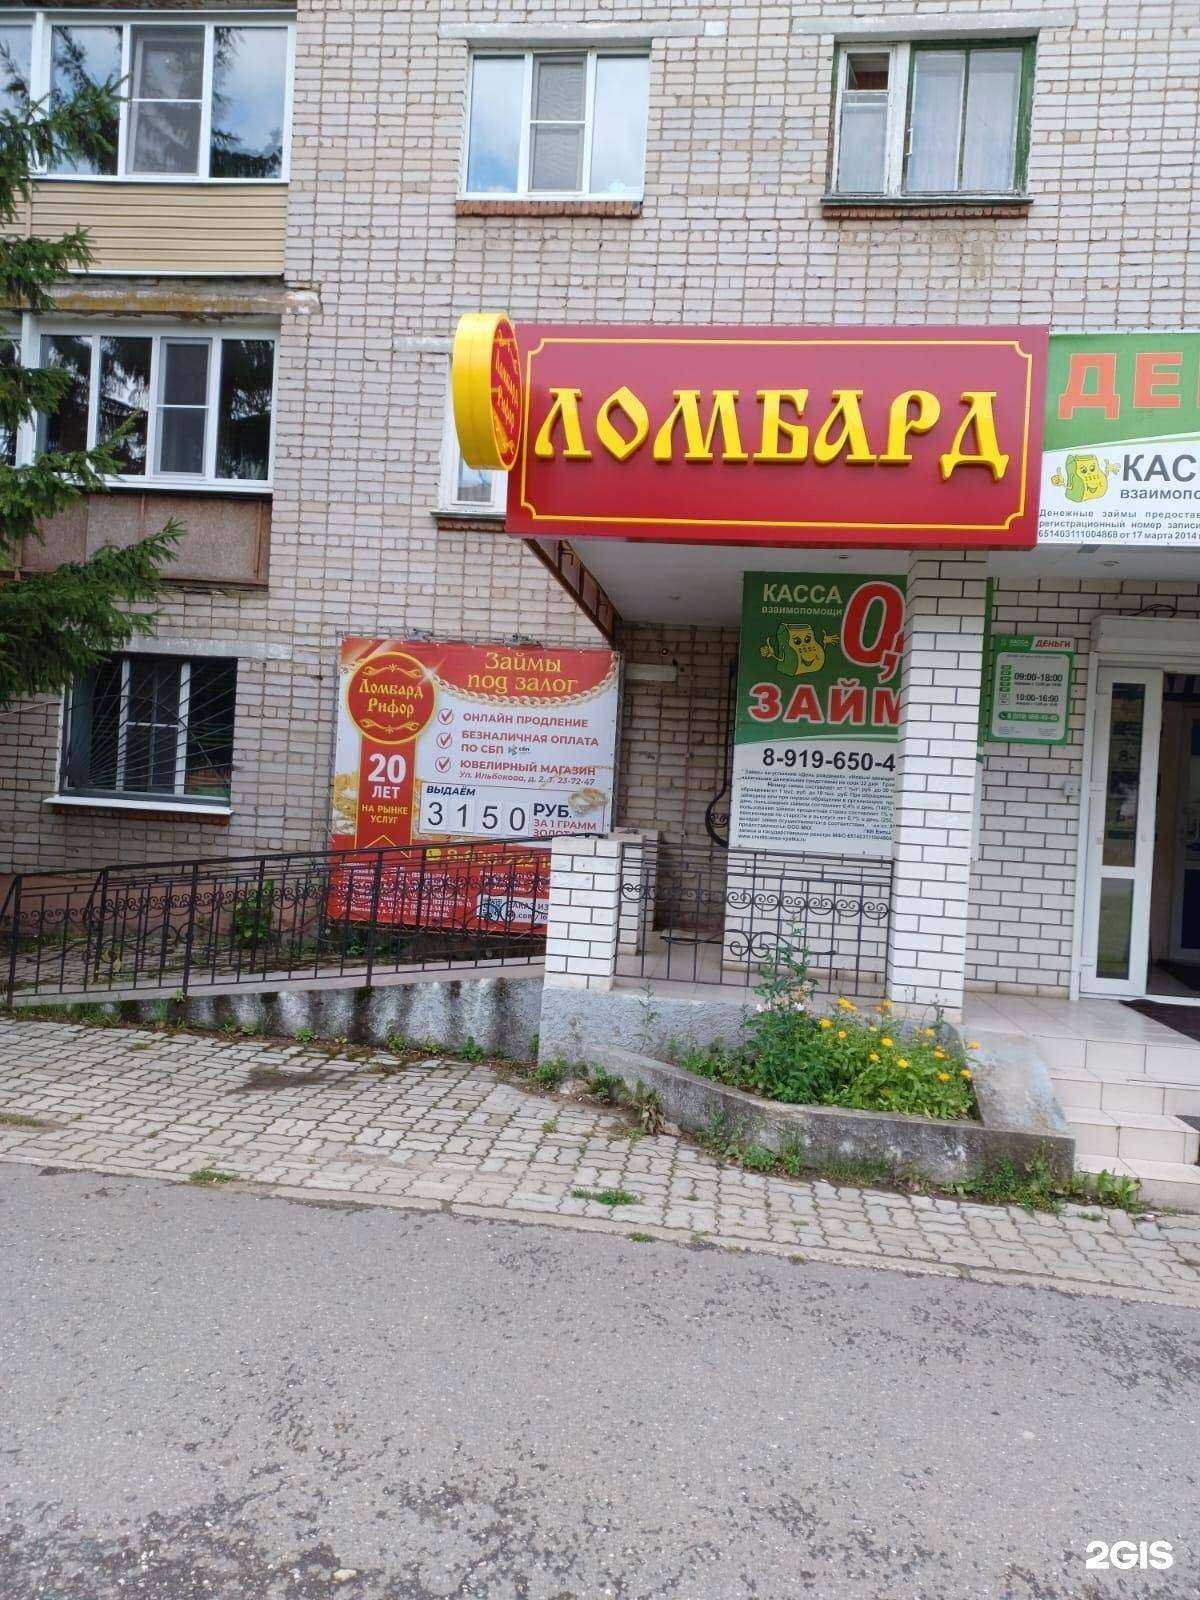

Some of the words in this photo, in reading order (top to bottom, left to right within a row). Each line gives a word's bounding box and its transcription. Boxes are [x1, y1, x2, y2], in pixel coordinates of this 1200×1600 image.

[1057, 352, 1200, 420] ДЕ
[534, 386, 1009, 481] ЛОМБАРД
[1039, 509, 1094, 518] Денежные
[1102, 510, 1137, 519] займы
[1039, 519, 1125, 529] регистрационный
[1131, 521, 1162, 530] номер
[1132, 531, 1143, 539] 17
[1144, 532, 1173, 540] марта
[1174, 531, 1197, 539] 2014
[763, 583, 843, 603] КАССА
[761, 606, 842, 617] взаимопомощи
[1035, 639, 1072, 648] ДЕНЬГИ
[485, 650, 562, 672] Займы
[359, 678, 424, 700] Ломбард
[468, 674, 508, 694] под
[515, 677, 578, 693] залог
[367, 697, 414, 718] Рифор
[463, 712, 513, 724] ОНЛАЙН
[516, 715, 588, 728] ПРОДЛЕНИЕ
[462, 730, 548, 743] БЕЗНАЛИЧНАЯ
[551, 735, 599, 746] ОПЛАТА
[461, 743, 478, 753] ПО
[480, 745, 503, 754] СБП
[763, 748, 896, 771] 8-919-650-4
[368, 753, 406, 783] 20
[460, 759, 537, 773] ЮВЕЛИРНЫЙ
[540, 765, 596, 776] МАГАЗИН
[371, 786, 400, 799] ЛЕТ
[426, 784, 476, 797] ВЫДАЁМ
[361, 804, 375, 813] НА
[377, 805, 409, 815] РЫНКЕ
[533, 803, 572, 818] РУБ.
[369, 815, 398, 824] УСЛУГ
[533, 819, 547, 828] ЗА
[557, 820, 596, 830] ГРАММ
